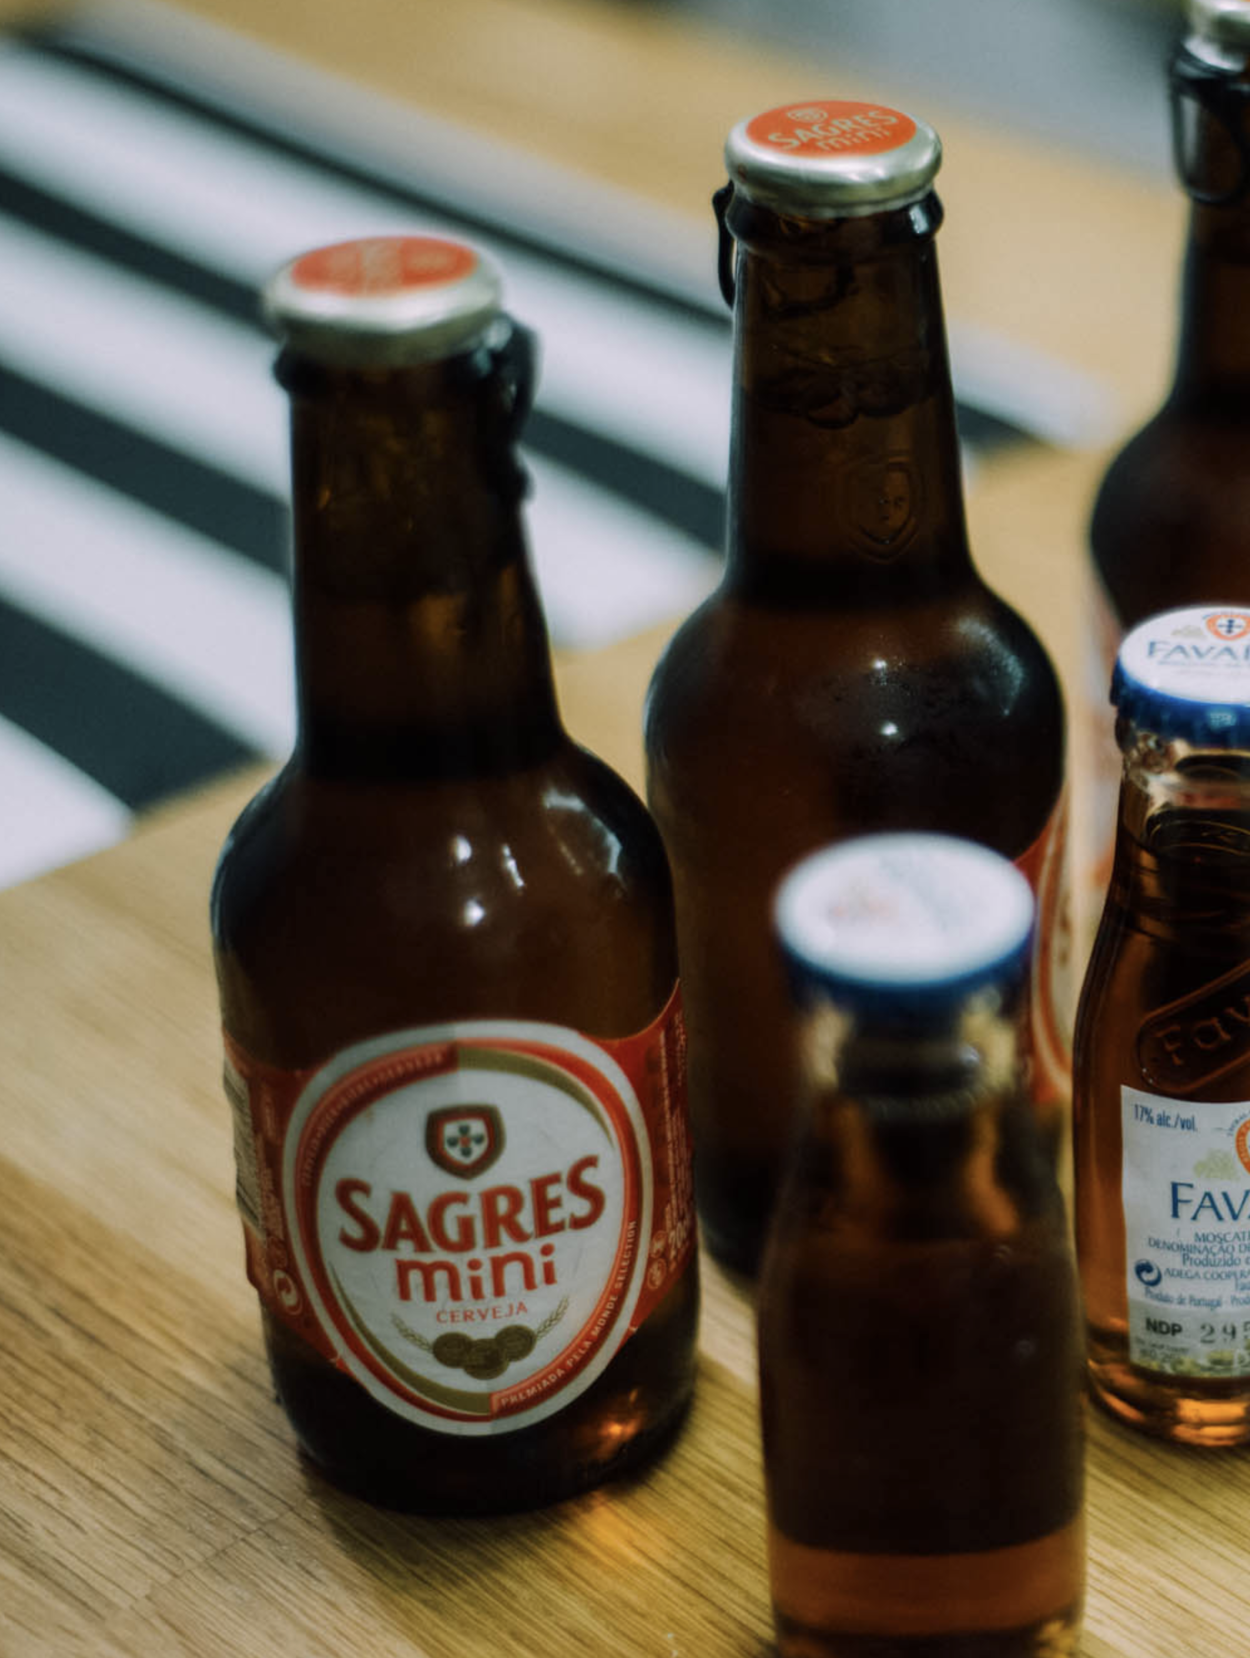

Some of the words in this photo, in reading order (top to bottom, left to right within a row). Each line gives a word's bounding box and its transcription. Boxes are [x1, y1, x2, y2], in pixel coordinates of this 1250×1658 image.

[768, 109, 899, 151] SAGRES
[815, 124, 890, 152] mini
[1133, 1104, 1155, 1125] 17%
[1156, 1110, 1198, 1133] alc./vol.
[334, 1154, 606, 1254] SAGRES
[1147, 1235, 1235, 1256] DENOMINAÇÃO
[395, 1242, 558, 1304] mini
[1164, 1267, 1201, 1280] ADEGA
[1181, 1252, 1242, 1268] Produzido
[436, 1302, 529, 1325] CERVEJA
[500, 1369, 566, 1407] PREMIADA
[566, 1340, 593, 1368] PELA
[590, 1294, 619, 1338] MONDE
[614, 1220, 638, 1290] SELECTION
[1145, 1317, 1183, 1337] NDP
